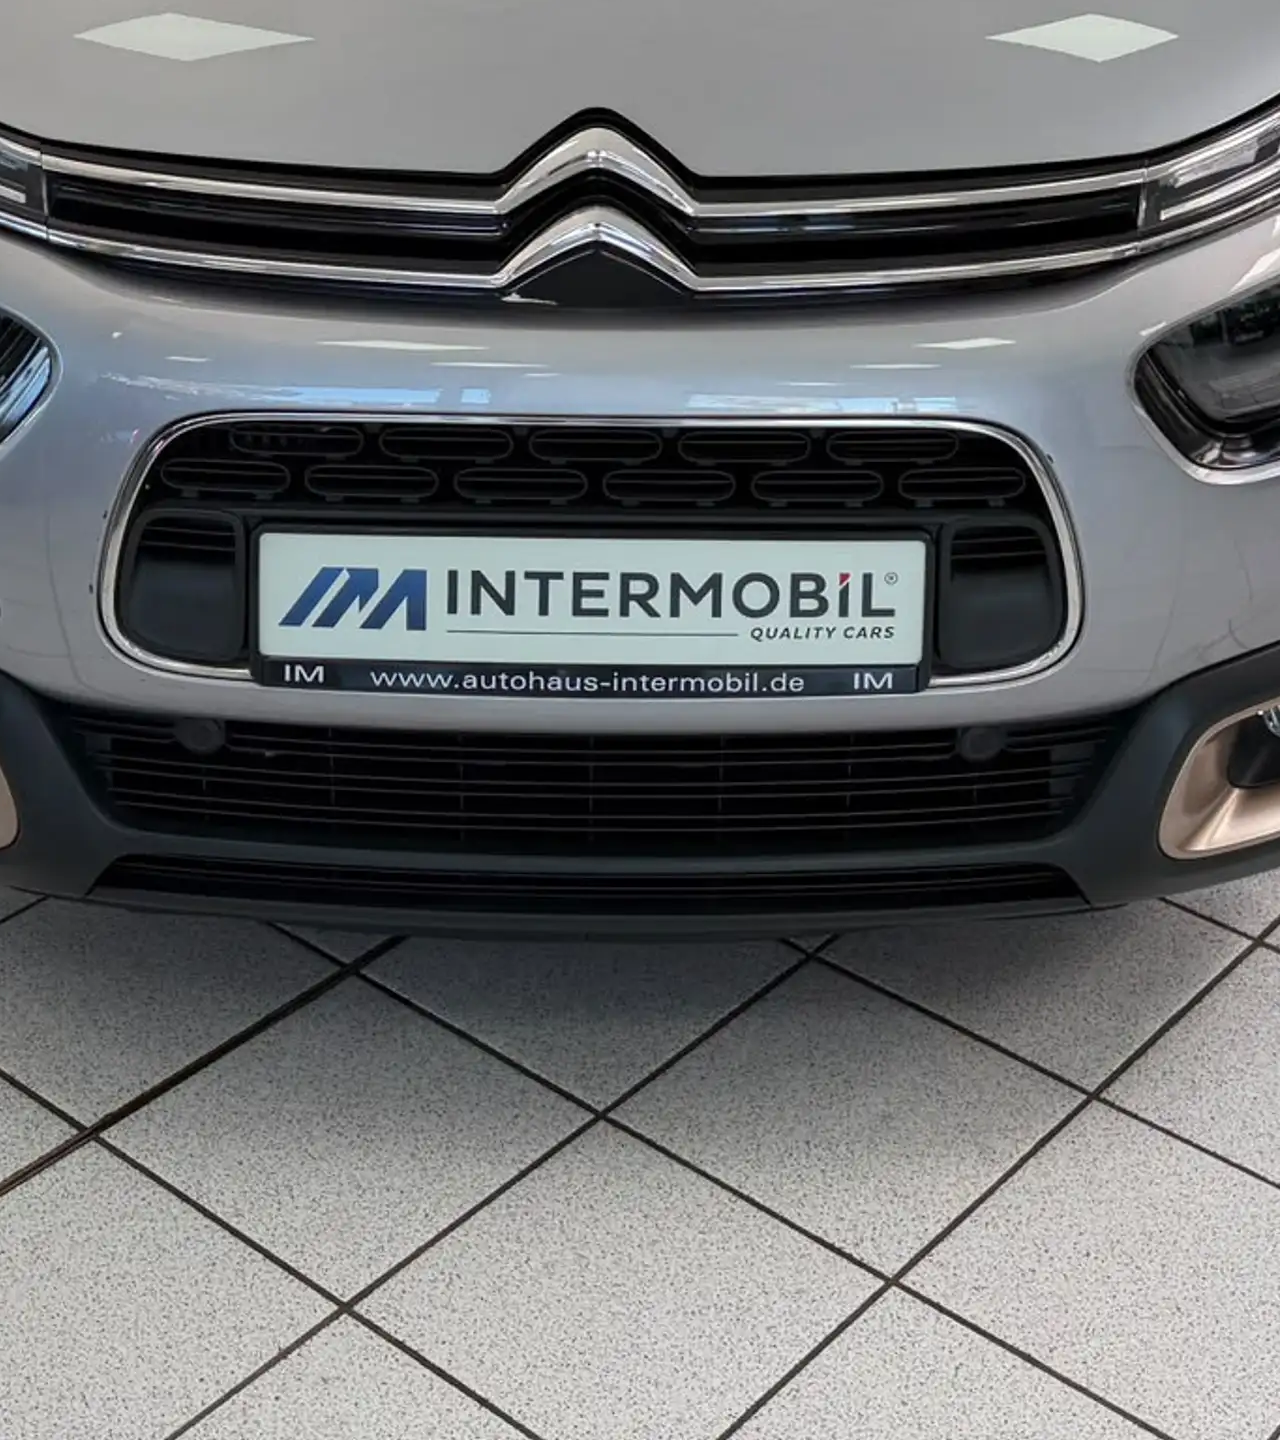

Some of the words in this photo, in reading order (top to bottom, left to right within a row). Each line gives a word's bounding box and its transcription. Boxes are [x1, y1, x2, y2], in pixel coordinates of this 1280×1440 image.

[750, 626, 837, 641] QUALITY
[843, 626, 896, 640] CARS
[284, 664, 325, 683] IM
[370, 670, 805, 693] www.autohaus-intermobil.de
[853, 672, 893, 690] IM
